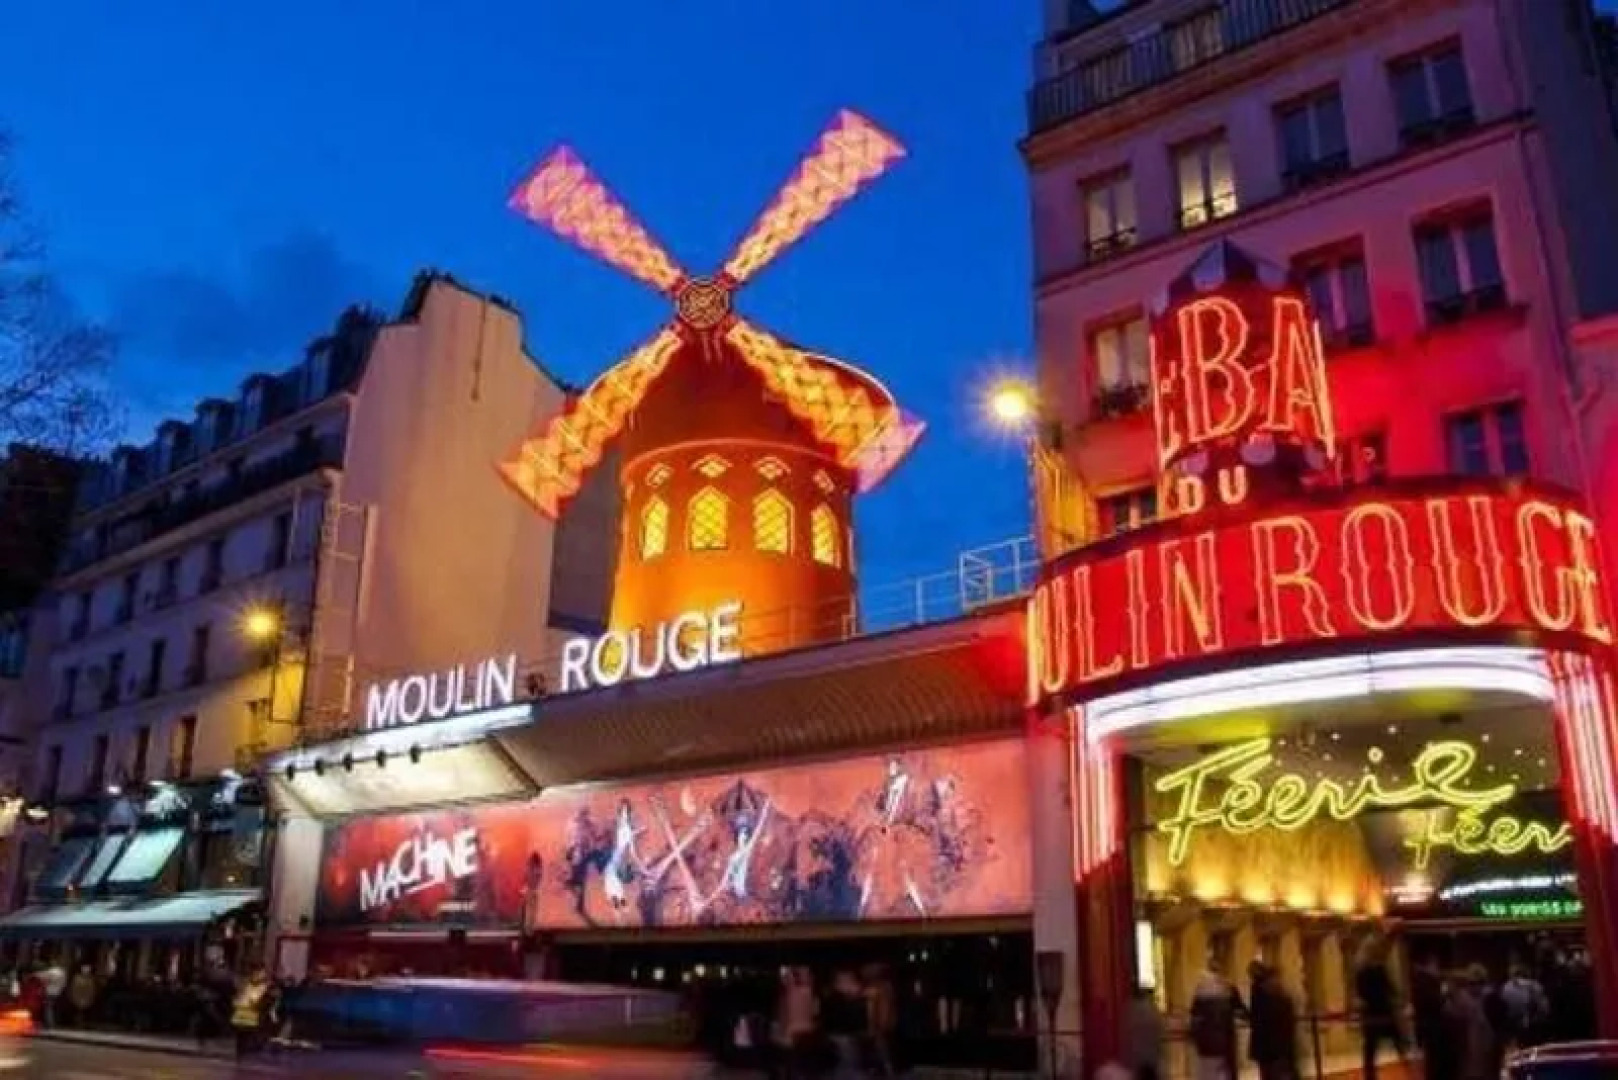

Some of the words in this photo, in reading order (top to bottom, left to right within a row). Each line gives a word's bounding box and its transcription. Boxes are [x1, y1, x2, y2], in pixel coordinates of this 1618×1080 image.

[1178, 464, 1247, 514] DU
[1250, 496, 1612, 645] ROUGE
[367, 655, 516, 728] MOULIN
[560, 600, 743, 691] ROUGE
[360, 828, 478, 911] MACHINE
